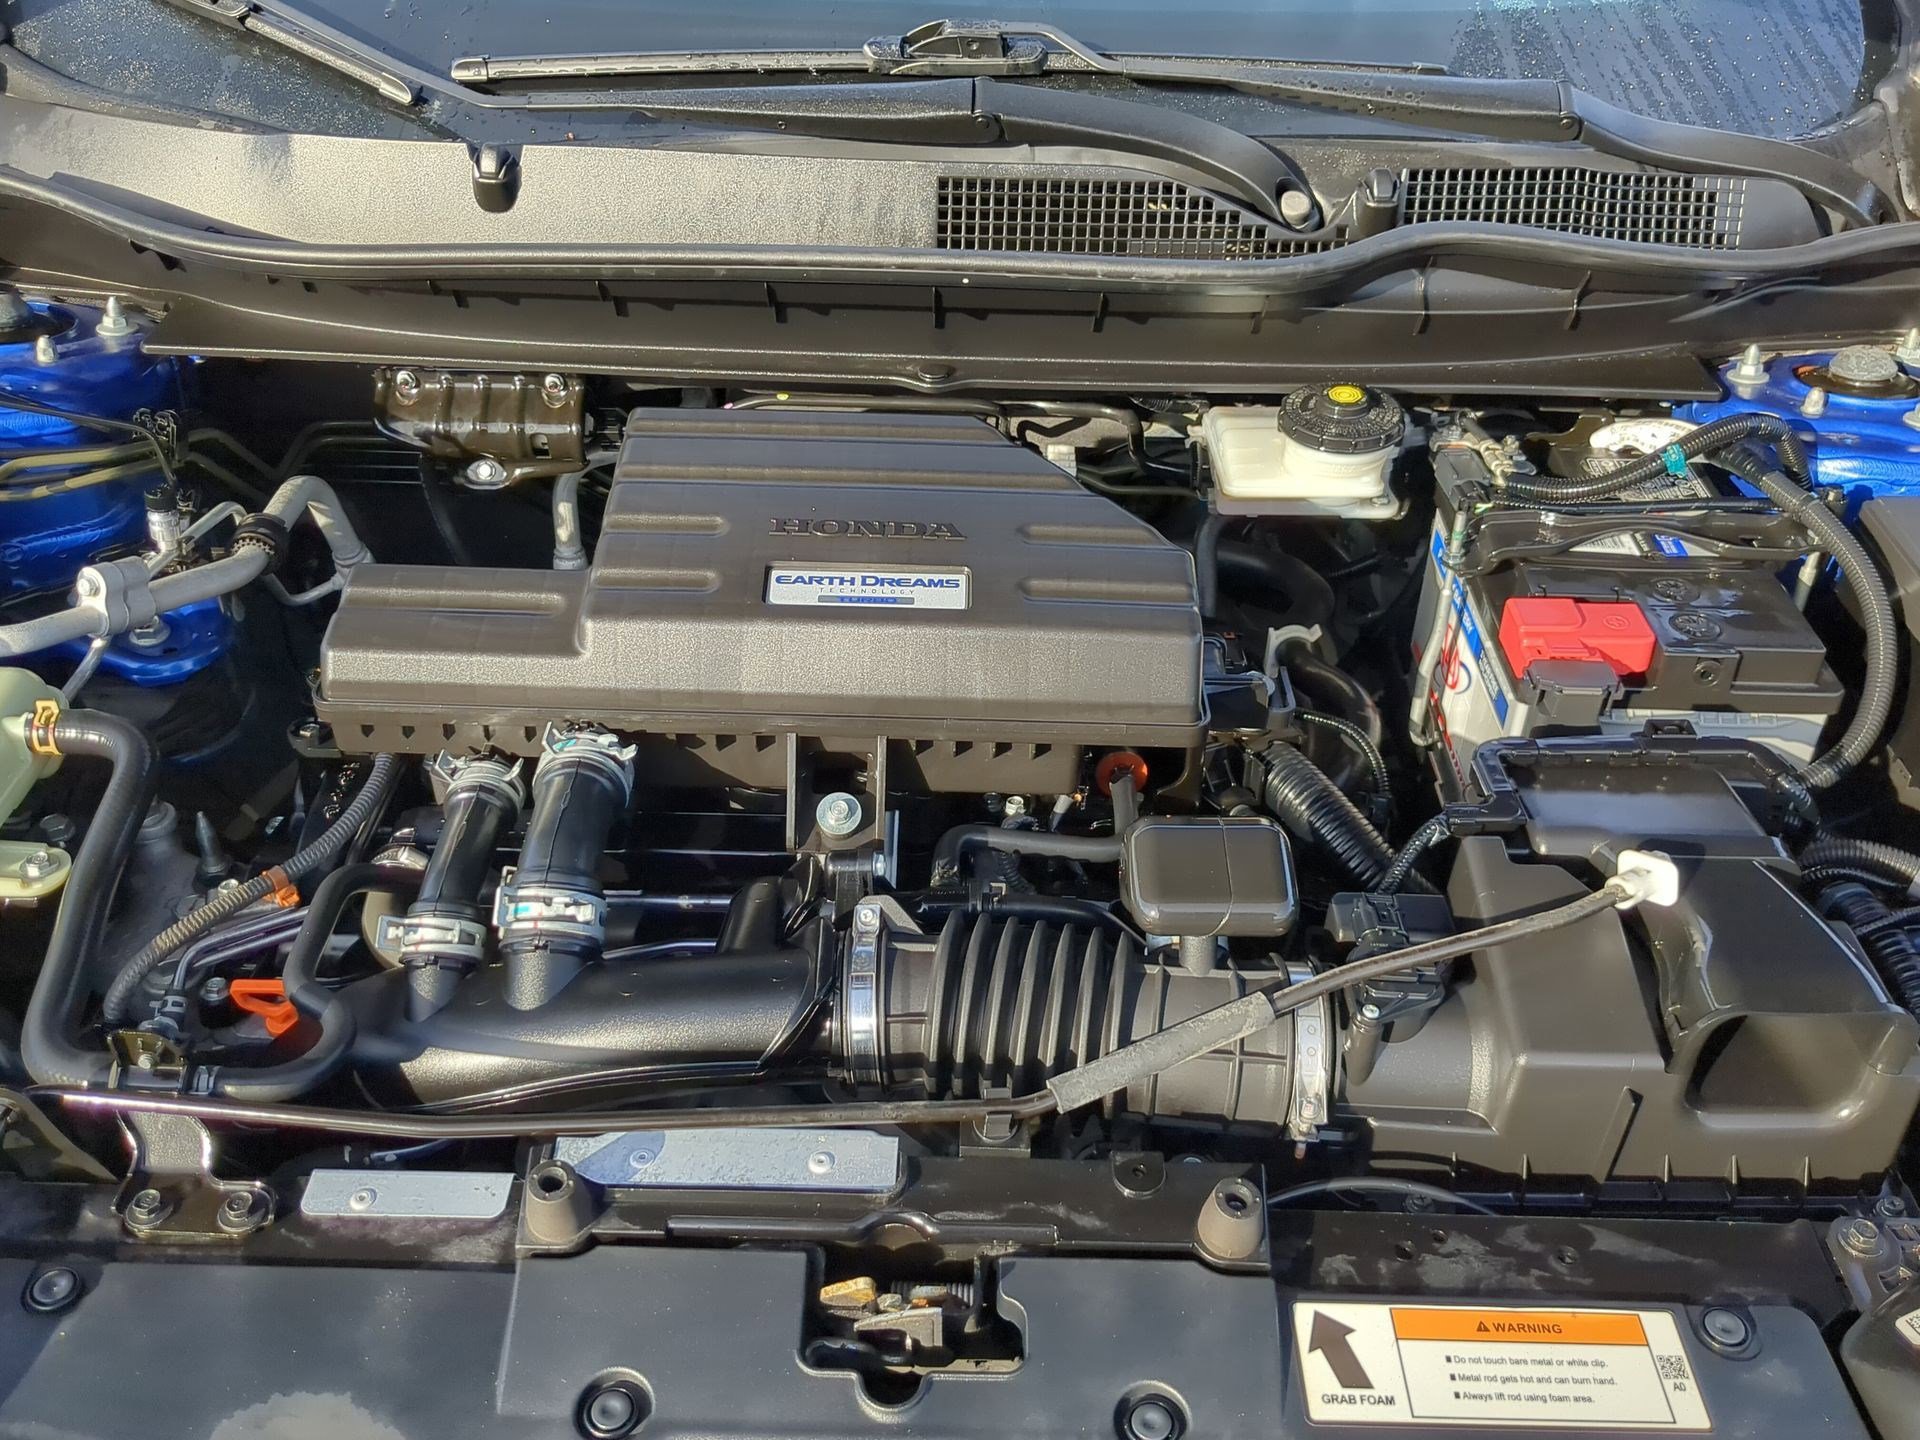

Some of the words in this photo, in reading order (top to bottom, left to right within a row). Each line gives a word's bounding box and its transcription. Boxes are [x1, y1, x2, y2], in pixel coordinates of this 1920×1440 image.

[769, 518, 967, 540] HONDA
[775, 575, 855, 586] EARTH
[860, 575, 961, 589] DREAMS
[819, 587, 915, 595] TECHNOLOGY
[1492, 1322, 1562, 1334] WARNING
[1453, 1355, 1466, 1364] Do
[1468, 1356, 1482, 1364] not
[1483, 1356, 1507, 1365] touch
[1508, 1357, 1528, 1365] bare
[1530, 1358, 1554, 1366] metal
[1567, 1358, 1589, 1367] white
[1591, 1359, 1608, 1368] clip.
[1458, 1373, 1482, 1382] Metal
[1484, 1374, 1498, 1382] rod
[1500, 1375, 1518, 1384] gets
[1520, 1375, 1534, 1383] hot
[1536, 1376, 1552, 1384] and
[1572, 1377, 1592, 1385] burn
[1593, 1377, 1618, 1385] hand.
[1321, 1394, 1357, 1404] GRAB
[1359, 1394, 1396, 1406] FOAM
[1463, 1391, 1493, 1402] Always
[1495, 1392, 1506, 1401] lift
[1507, 1392, 1522, 1401] rod
[1524, 1393, 1548, 1403] using
[1549, 1394, 1572, 1402] foam
[1573, 1395, 1595, 1403] area.
